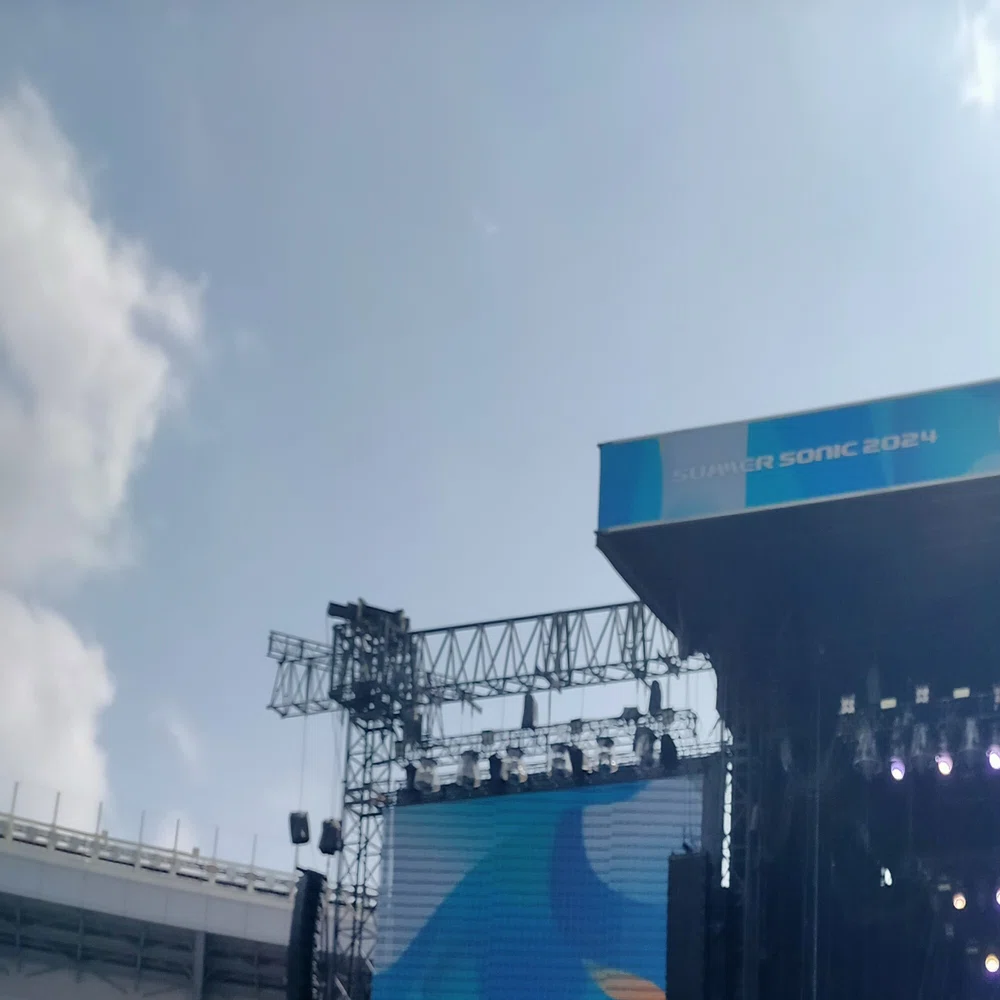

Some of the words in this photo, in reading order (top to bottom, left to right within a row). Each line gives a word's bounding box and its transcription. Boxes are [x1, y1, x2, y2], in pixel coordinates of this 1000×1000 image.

[671, 454, 774, 482] SUMMER
[779, 440, 859, 468] SONIC
[862, 428, 938, 455] 2024
